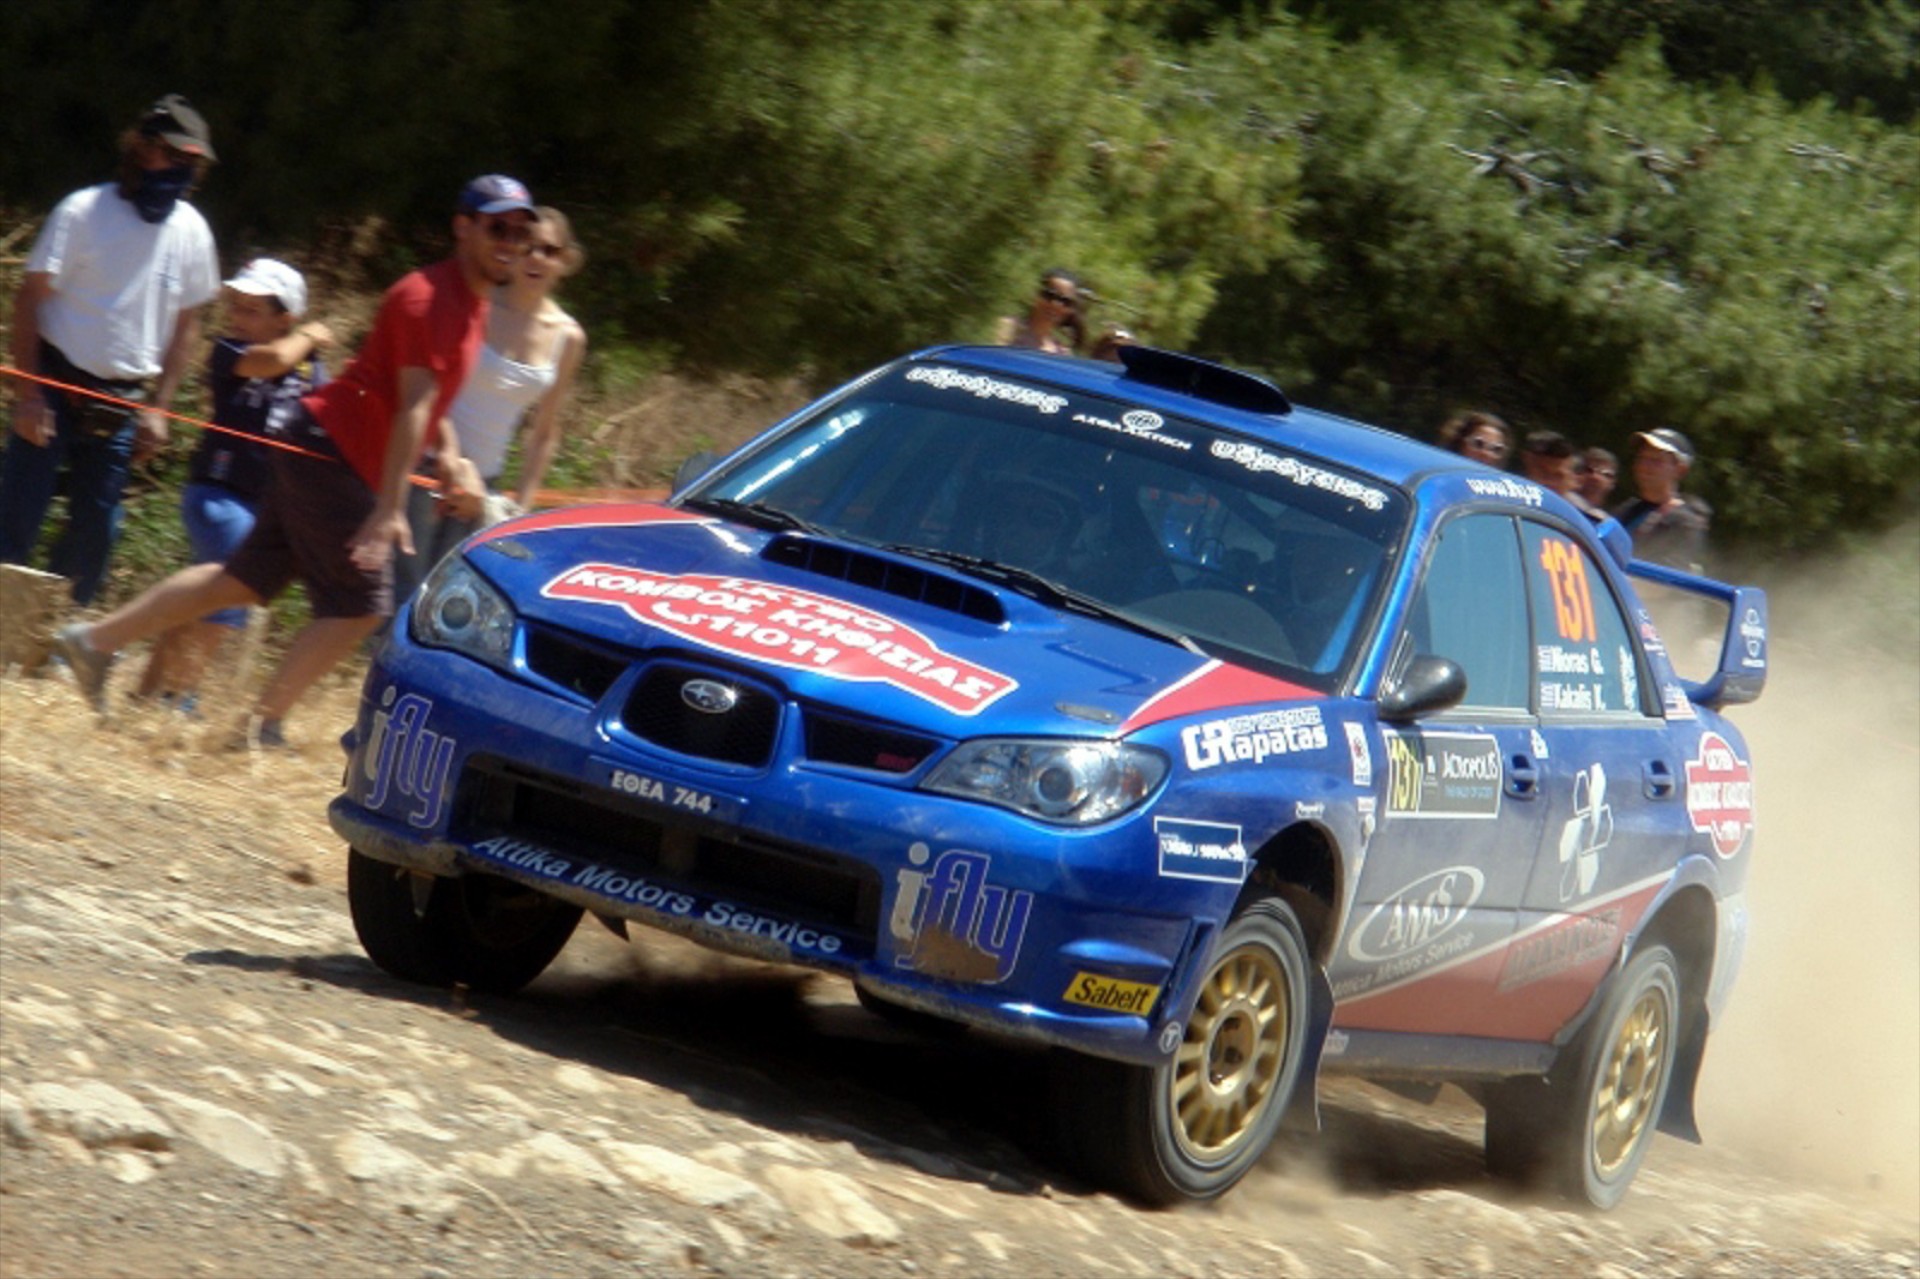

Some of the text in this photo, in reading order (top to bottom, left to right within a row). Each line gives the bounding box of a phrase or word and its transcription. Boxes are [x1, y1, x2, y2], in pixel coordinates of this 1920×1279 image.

[567, 570, 997, 701] ΚΟΜΒΟΣ ΚΗΦΙΣΙΑΣ
[1539, 538, 1597, 643] 131
[672, 787, 713, 814] 744
[473, 836, 843, 954] Attika Motors Service
[1379, 873, 1458, 951] AMS
[1073, 978, 1153, 1012] Sabelt
